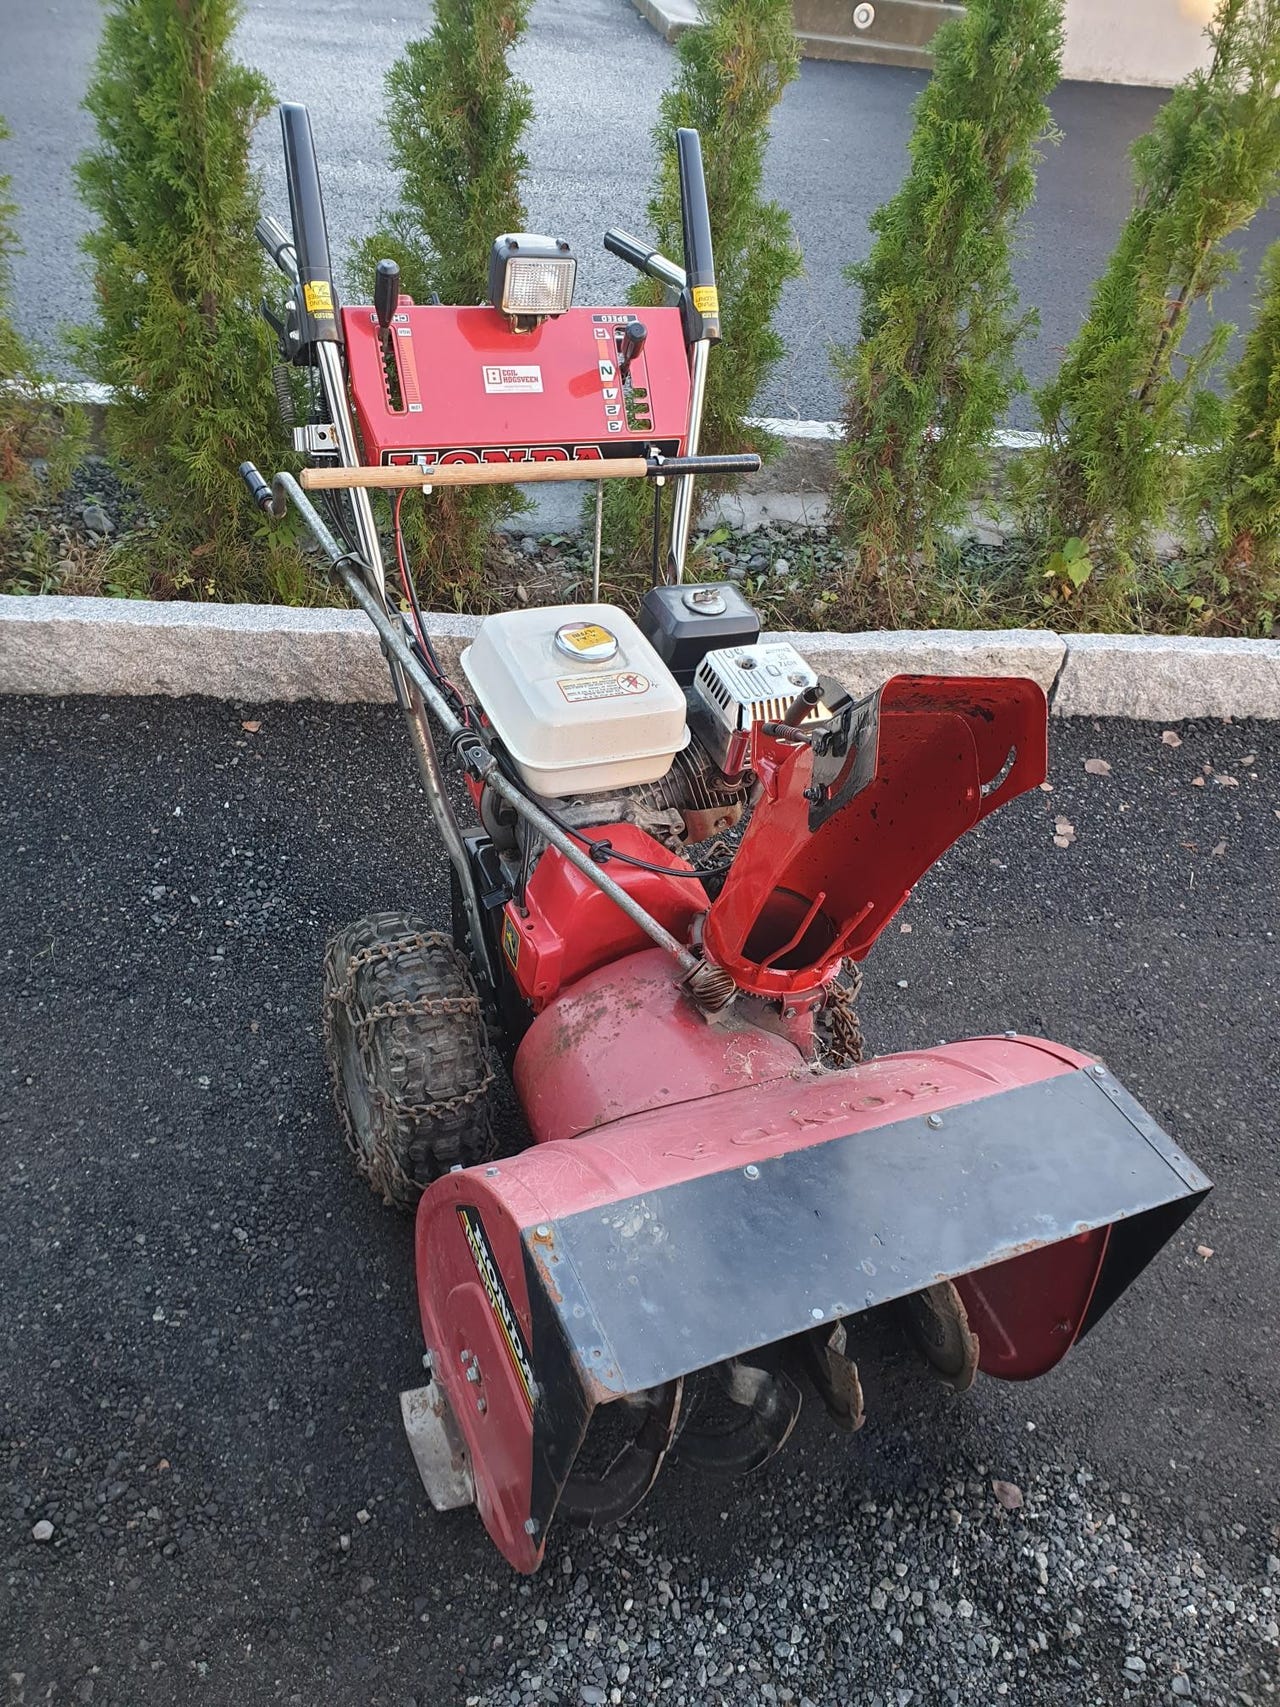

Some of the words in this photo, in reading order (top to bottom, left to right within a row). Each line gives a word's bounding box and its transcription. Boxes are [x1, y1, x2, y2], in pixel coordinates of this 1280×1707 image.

[600, 314, 629, 323] SPEED
[595, 330, 605, 338] R
[606, 389, 614, 398] 1
[607, 405, 617, 414] 2
[609, 421, 619, 431] 3
[473, 1222, 536, 1388] HONDA
